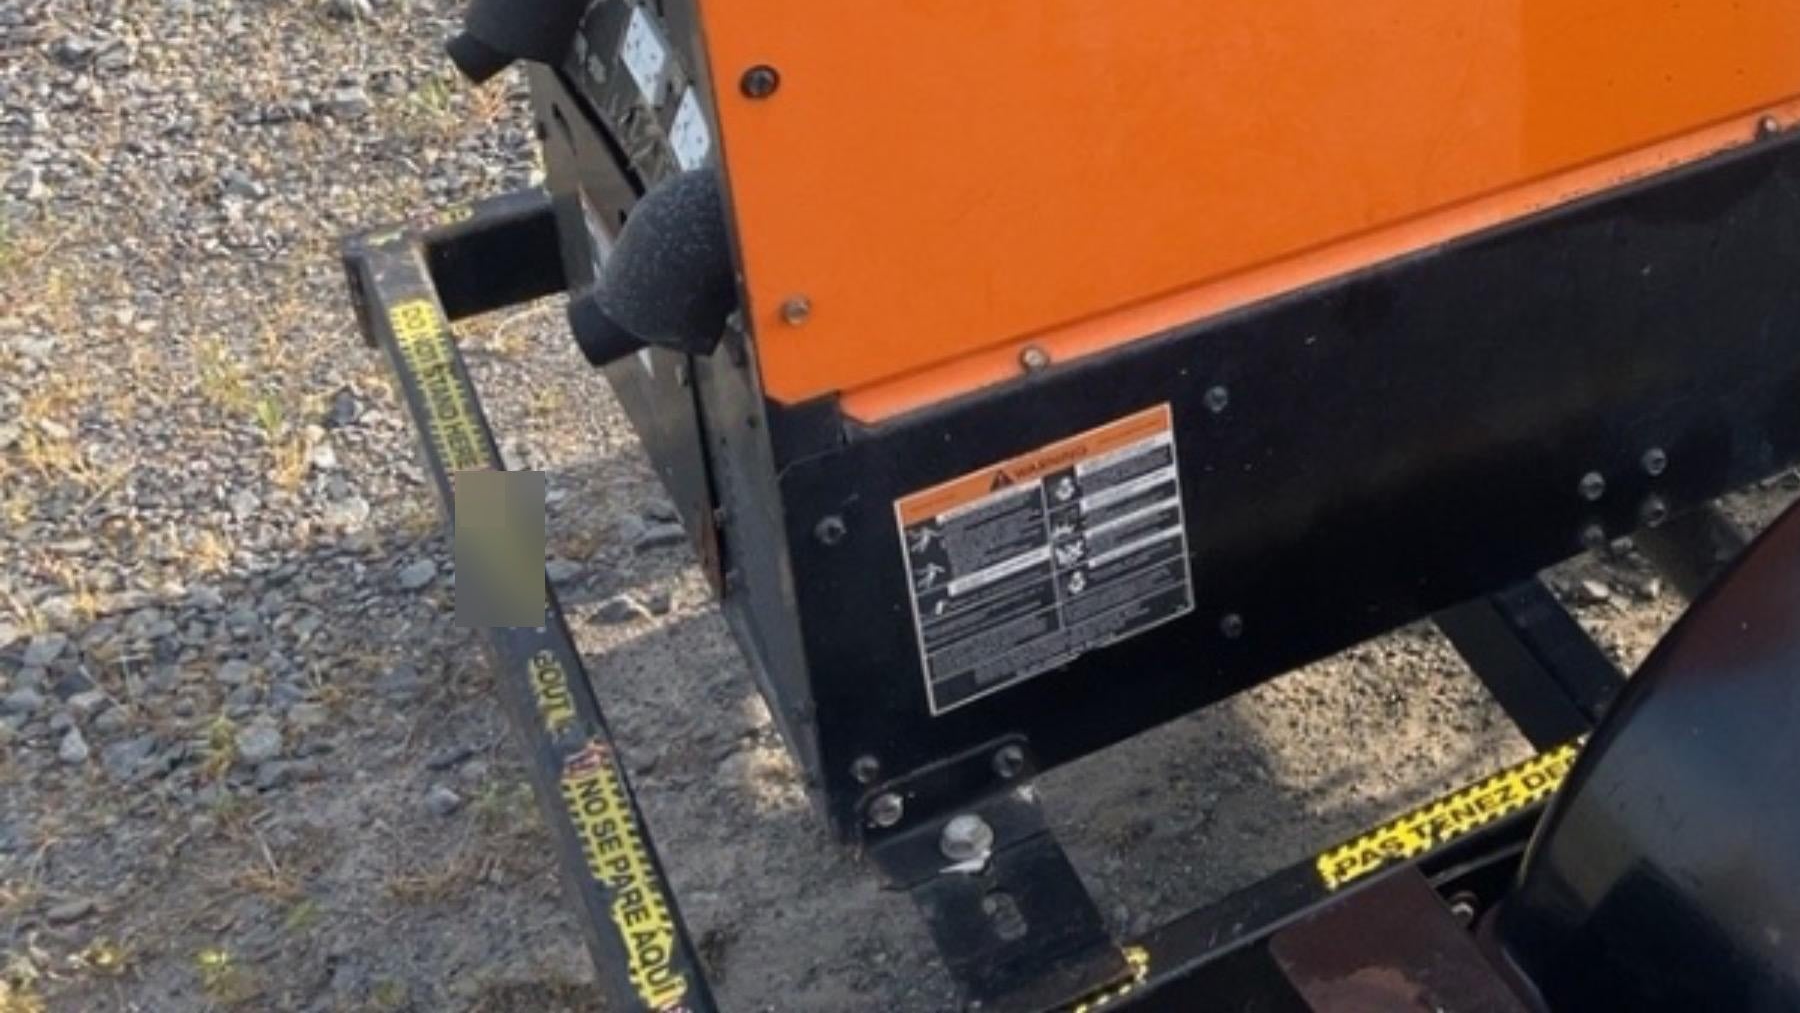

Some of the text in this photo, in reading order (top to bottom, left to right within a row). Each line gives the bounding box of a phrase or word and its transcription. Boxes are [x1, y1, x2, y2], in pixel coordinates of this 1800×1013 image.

[575, 778, 610, 816] NO
[591, 819, 622, 855] SE
[1333, 834, 1405, 877] PAS
[1407, 785, 1519, 838] TENEZ
[604, 855, 650, 927] PARE
